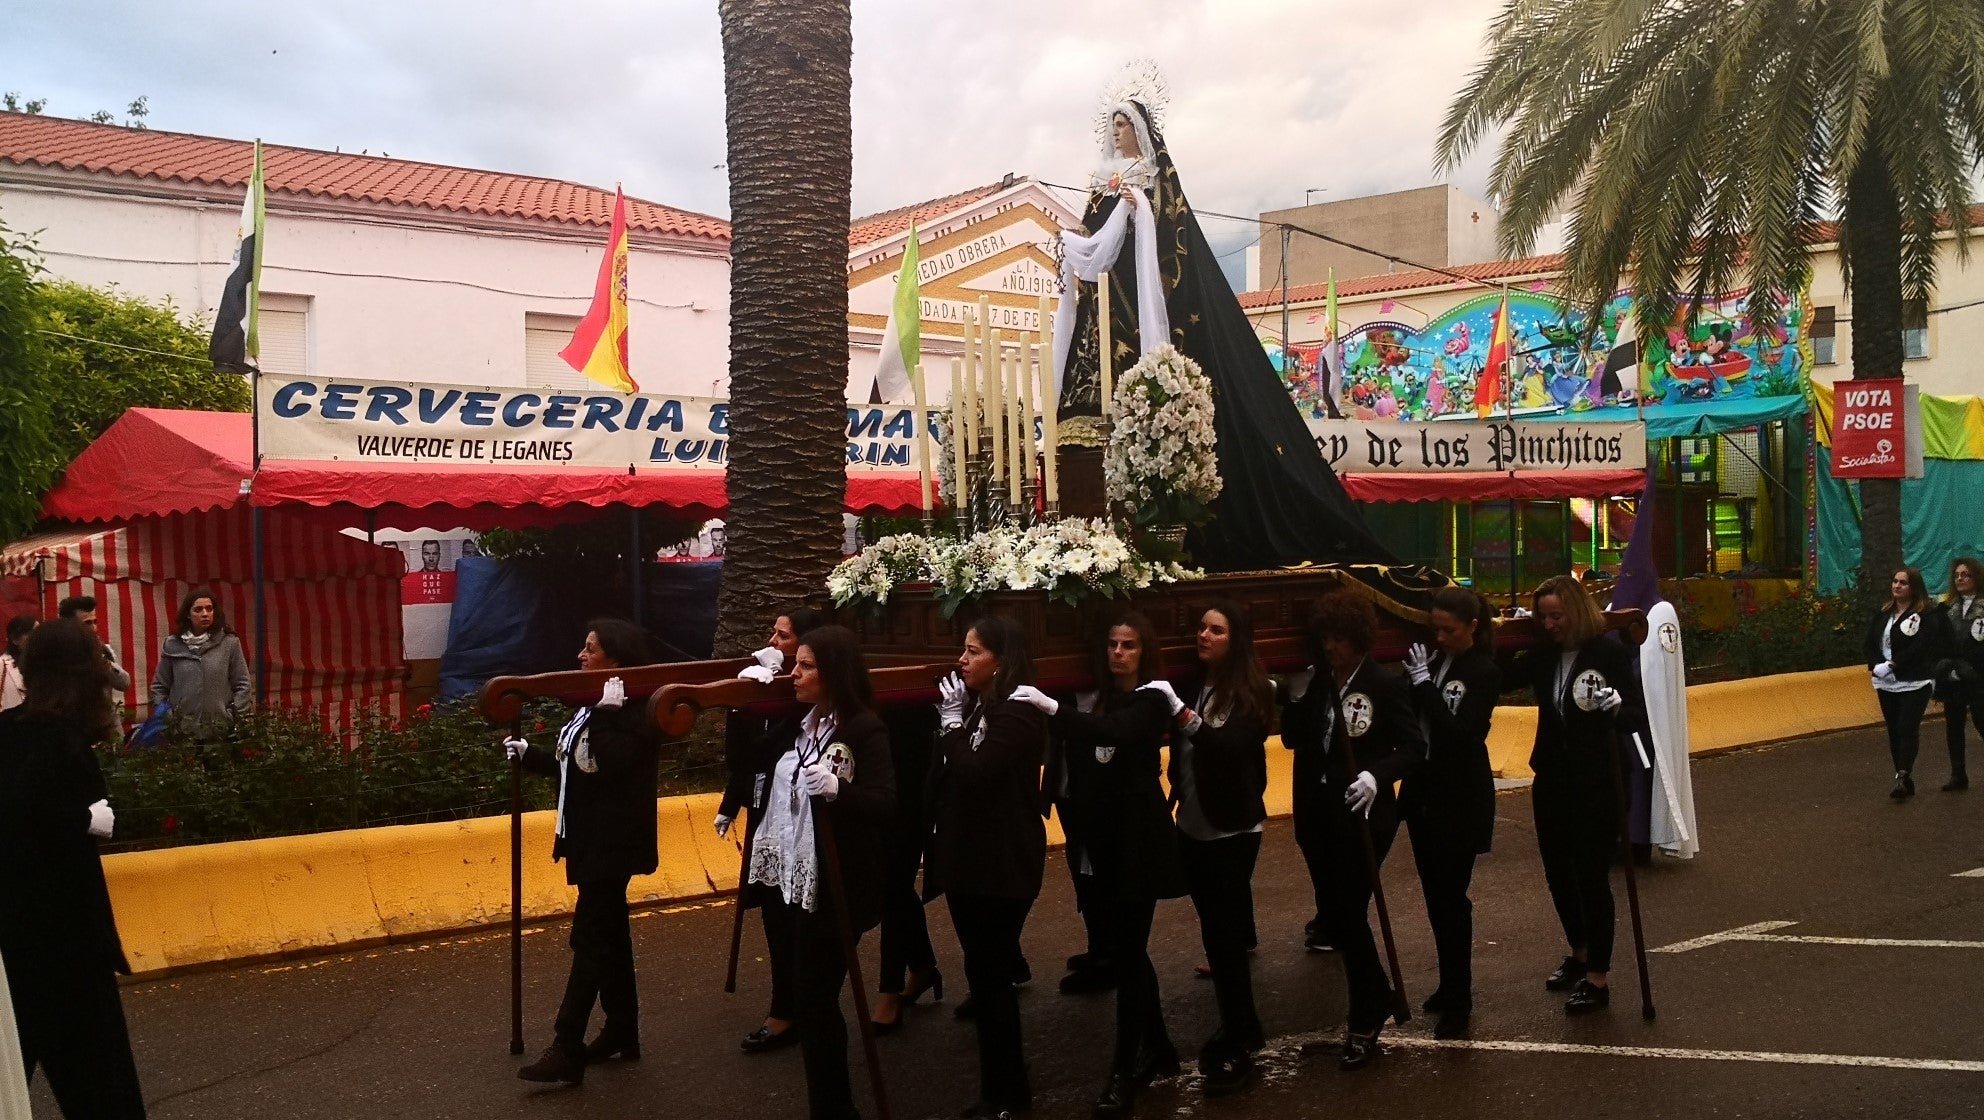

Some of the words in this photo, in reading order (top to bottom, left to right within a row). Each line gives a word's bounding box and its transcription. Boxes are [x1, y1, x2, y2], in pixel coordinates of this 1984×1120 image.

[892, 252, 955, 285] SIEDAD
[1004, 309, 1019, 326] DE
[272, 382, 685, 434] CERVECERIA
[1845, 389, 1892, 408] VOTA
[1842, 412, 1893, 431] PSOE
[357, 434, 455, 458] VALVERDE
[460, 438, 486, 459] DE
[491, 440, 573, 462] LEGANES
[650, 436, 724, 465] LUI
[846, 442, 910, 467] RIN
[1314, 433, 1349, 474] ey
[1365, 427, 1403, 468] de
[1418, 429, 1470, 468] los
[1487, 423, 1624, 472] Pinchitos
[1839, 451, 1896, 469] Socialistas
